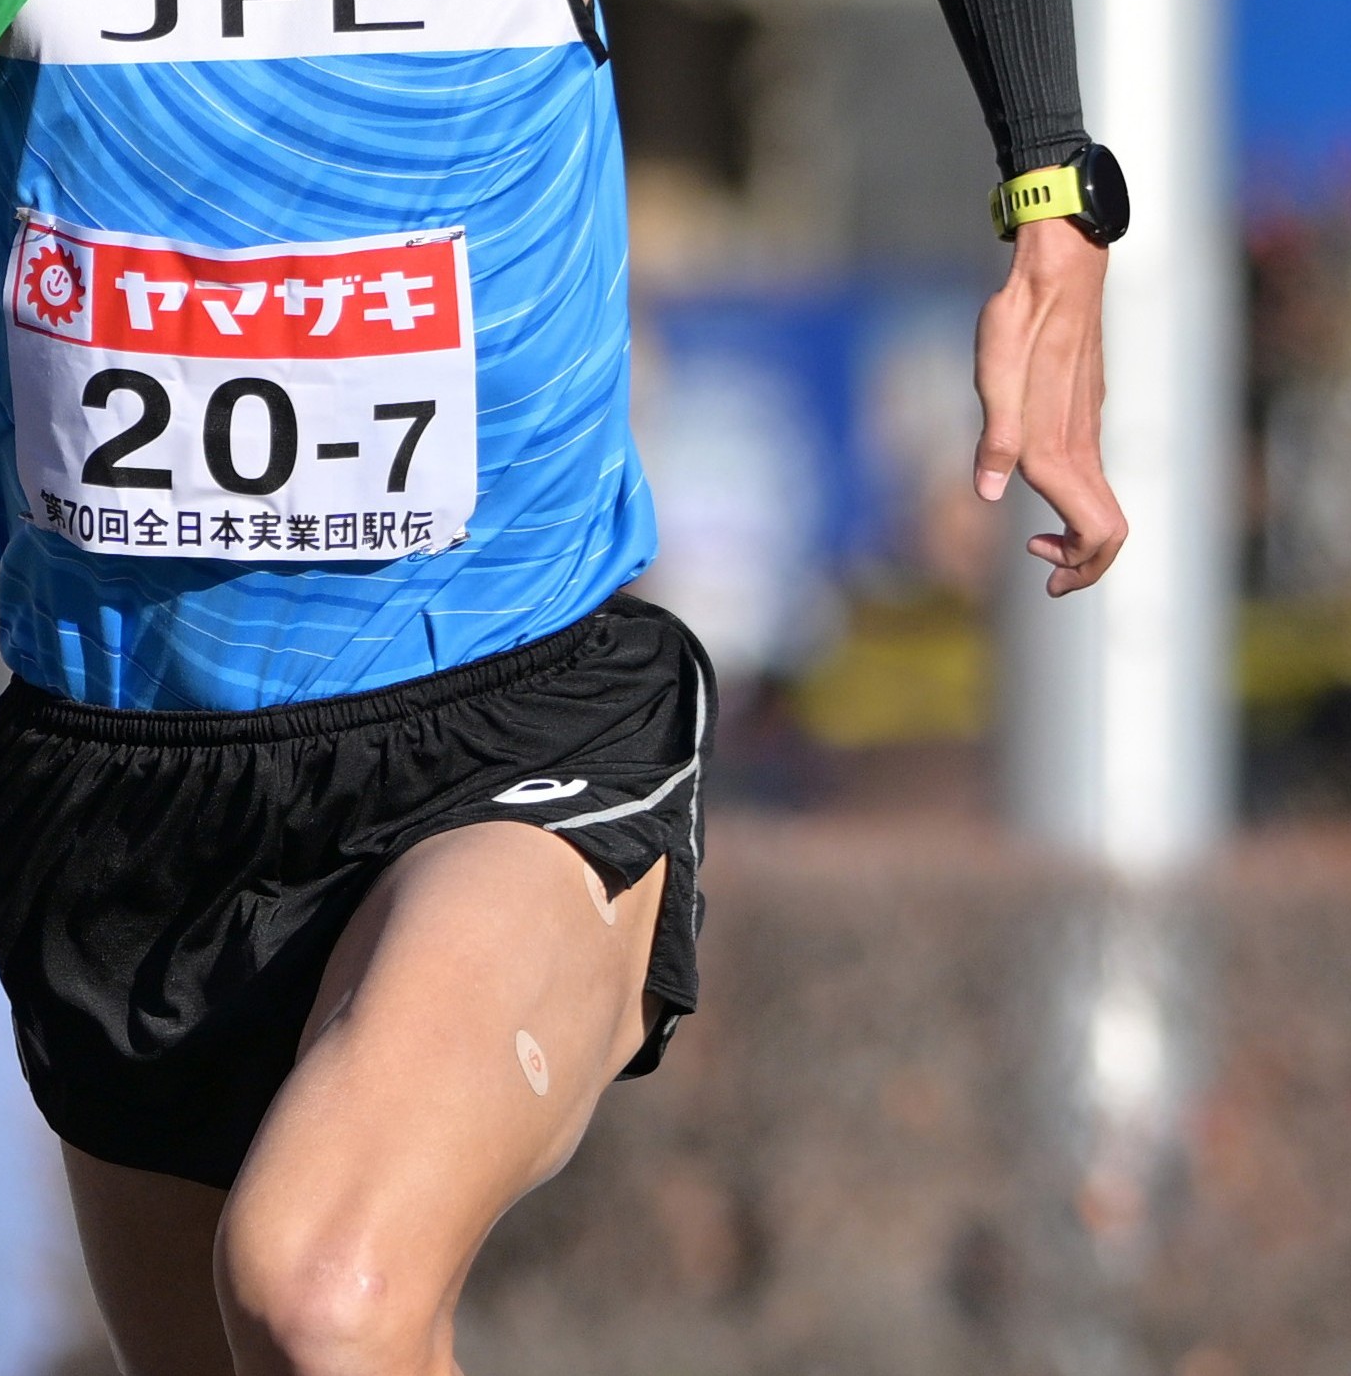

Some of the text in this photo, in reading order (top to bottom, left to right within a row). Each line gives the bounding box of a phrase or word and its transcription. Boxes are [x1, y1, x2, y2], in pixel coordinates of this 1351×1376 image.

[114, 271, 436, 336] ヤマザキ
[81, 367, 436, 496] 20-7
[39, 488, 434, 551] 第70回全日本実業団駅伝
